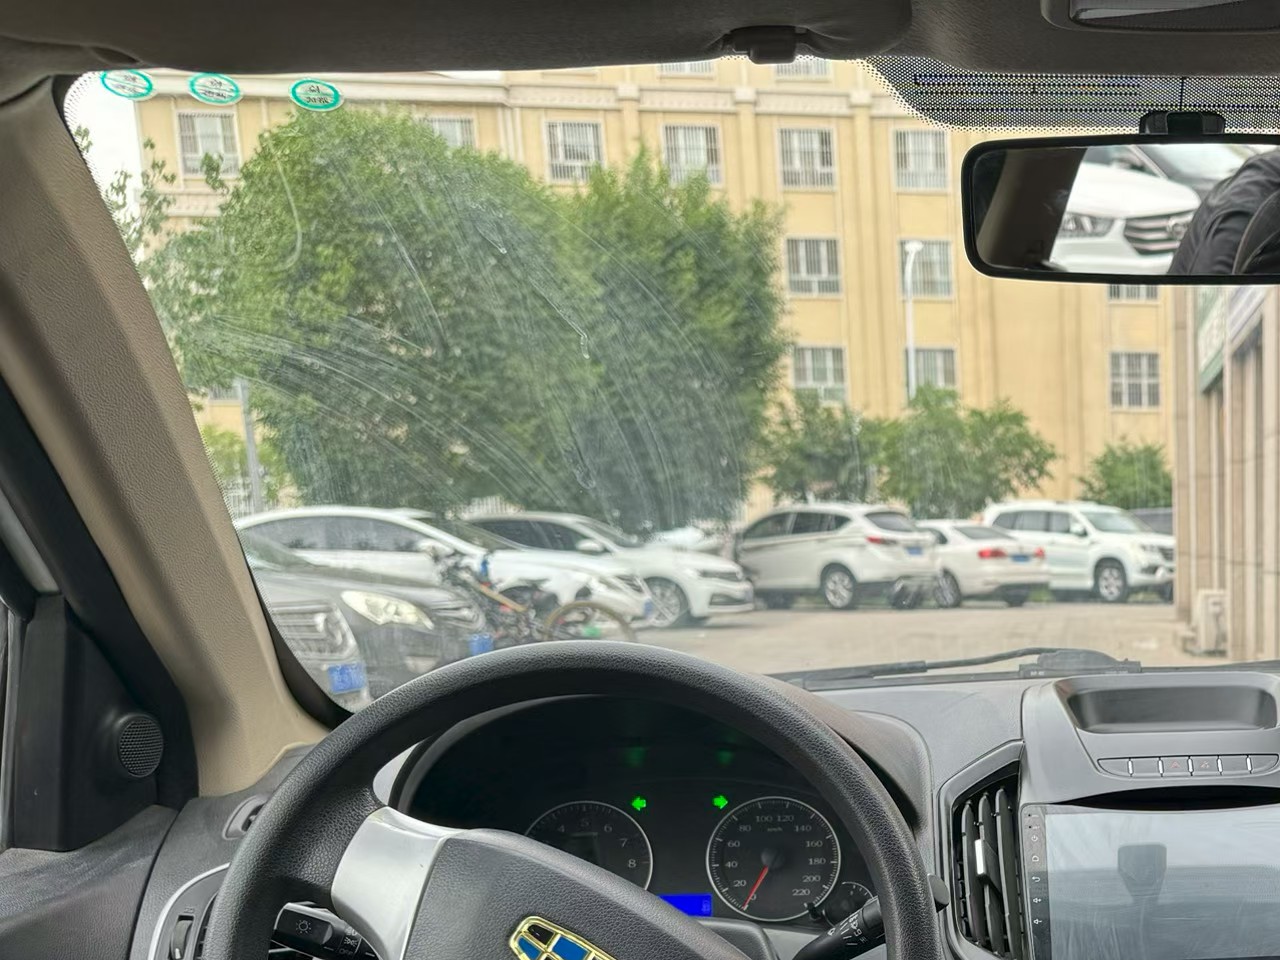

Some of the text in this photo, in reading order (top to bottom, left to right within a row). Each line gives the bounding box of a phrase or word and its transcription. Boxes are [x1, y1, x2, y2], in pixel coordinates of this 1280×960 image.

[604, 824, 613, 832] 6
[619, 838, 628, 848] 7
[628, 859, 637, 868] 8
